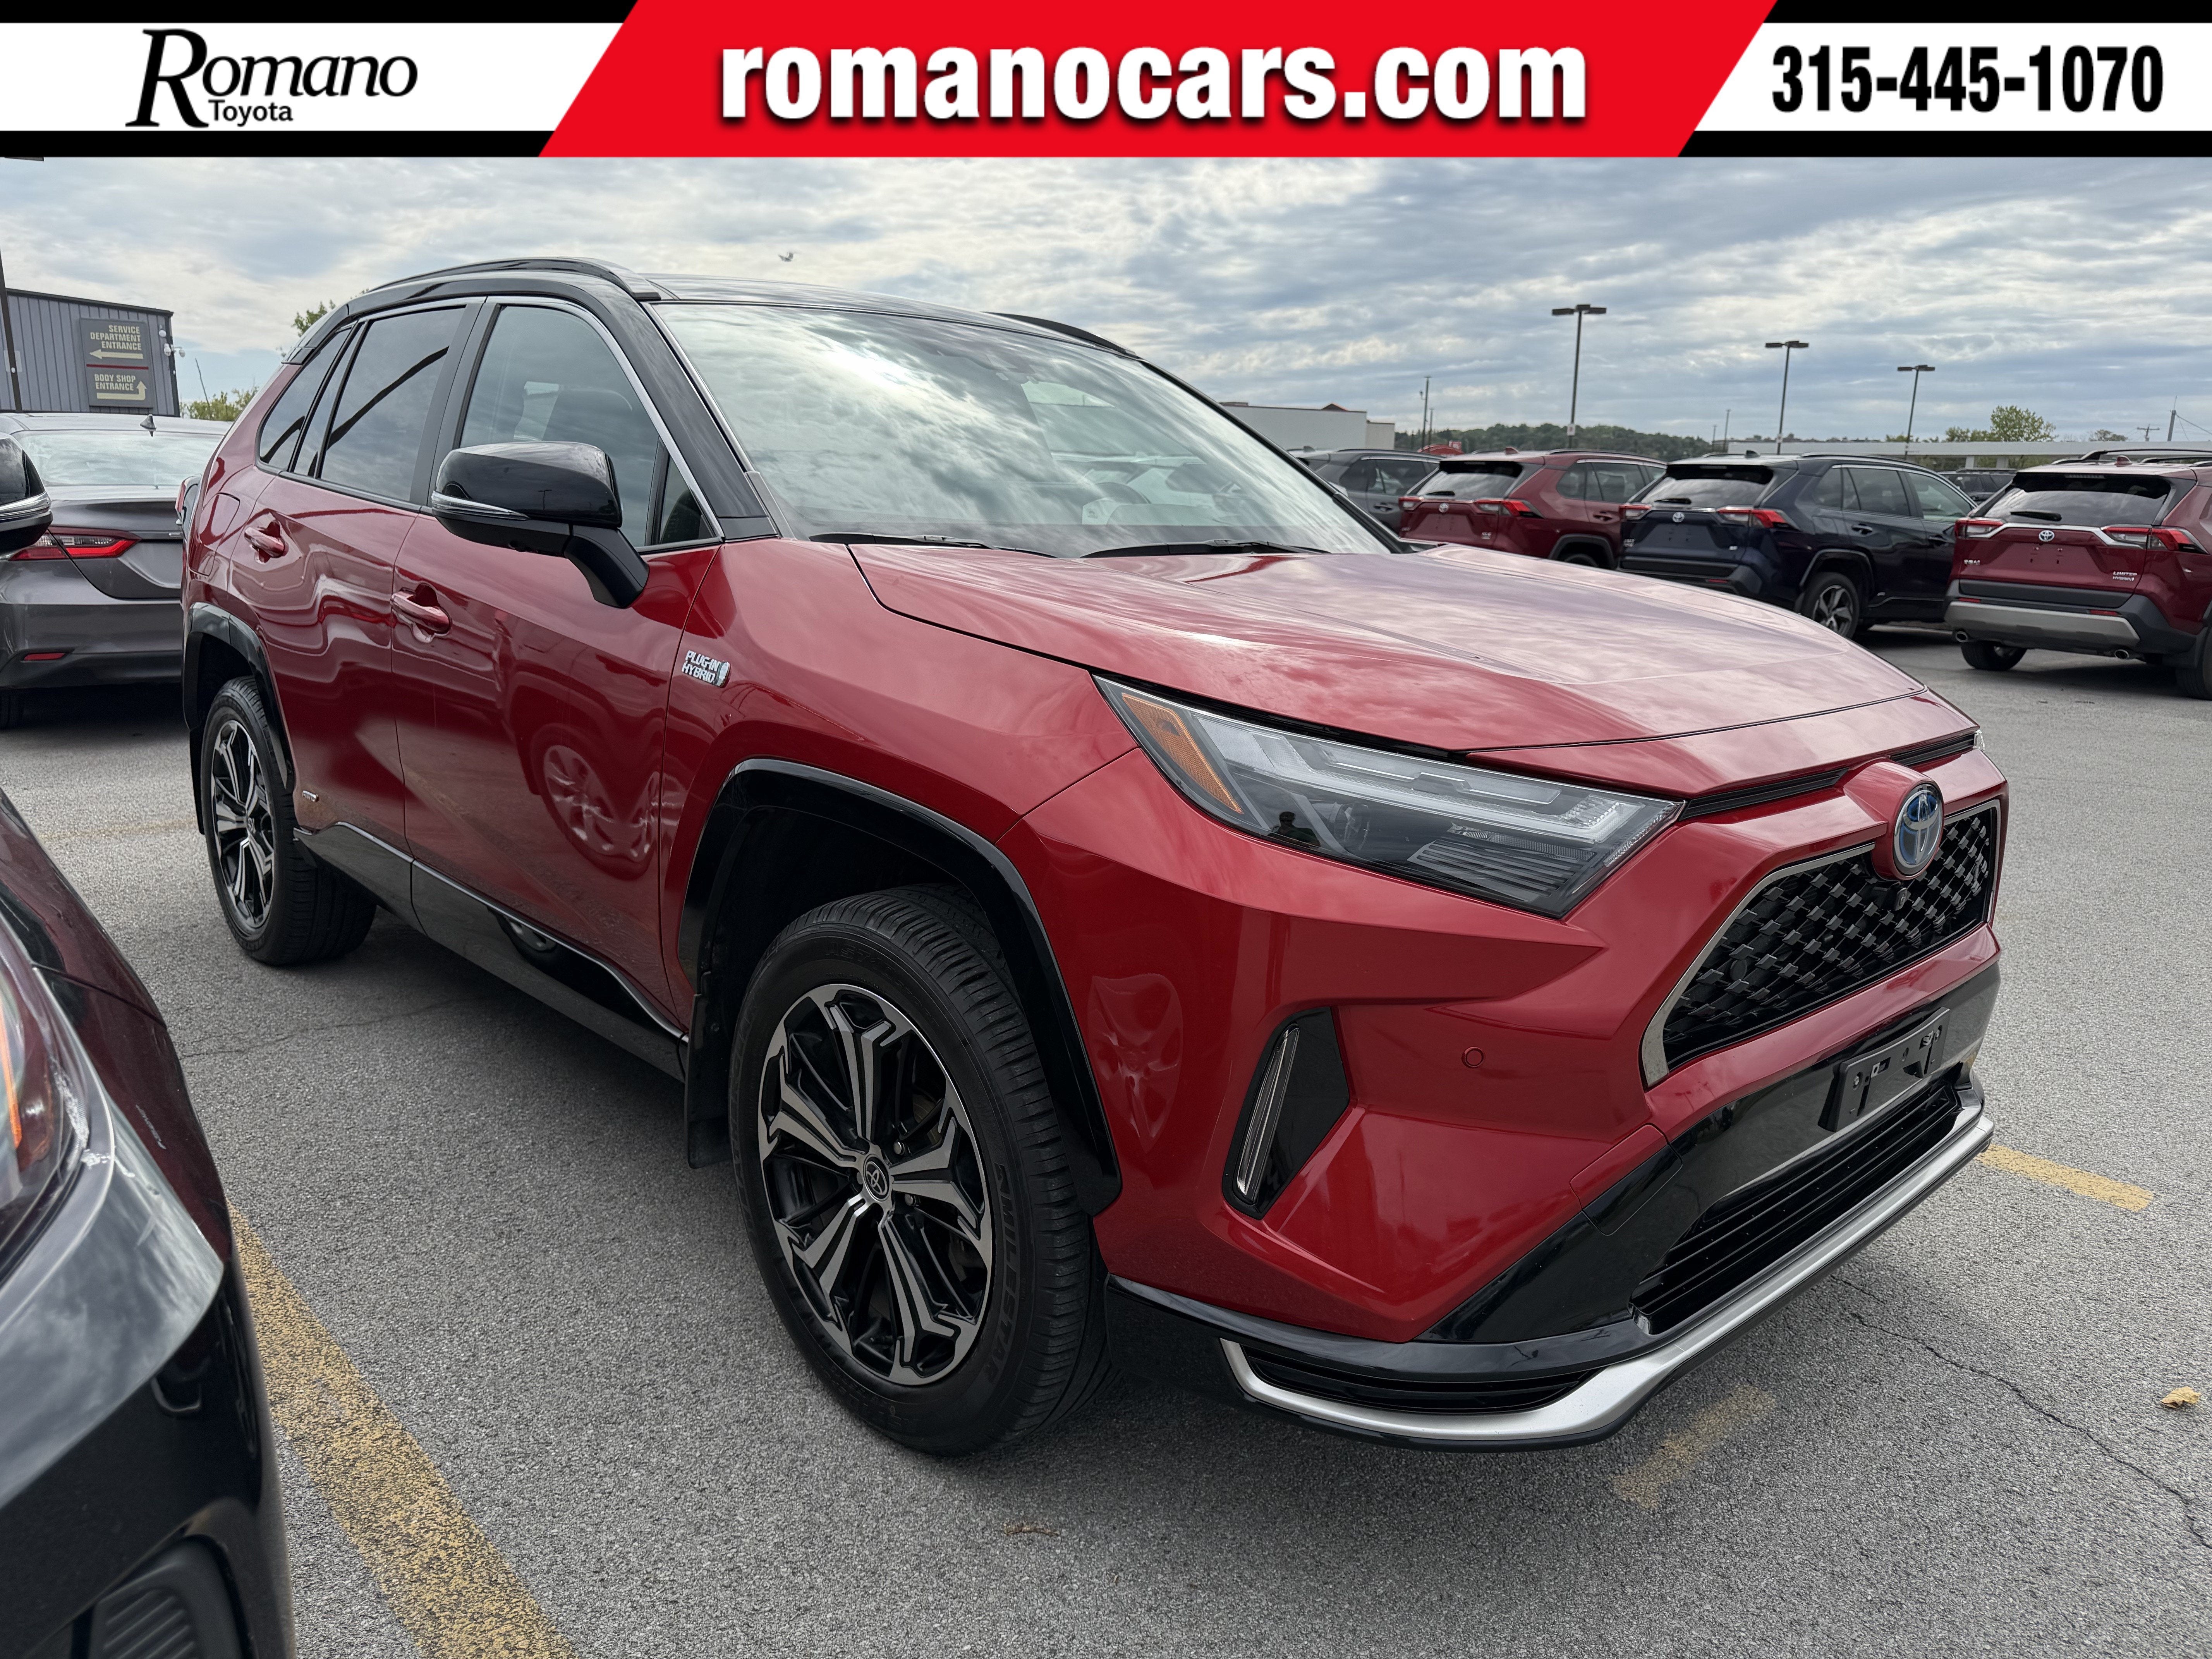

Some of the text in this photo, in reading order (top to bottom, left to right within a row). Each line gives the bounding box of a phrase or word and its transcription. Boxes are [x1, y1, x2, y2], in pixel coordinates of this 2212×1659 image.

[108, 325, 140, 334] SERVICE
[90, 332, 141, 342] DEPARTMENT
[101, 341, 142, 350] ENTRANCE
[96, 382, 134, 391] ENTRANCE
[685, 650, 721, 672] PLUG-IN
[682, 662, 716, 684] HYBRID
[982, 1197, 1018, 1388] MILESTAR
